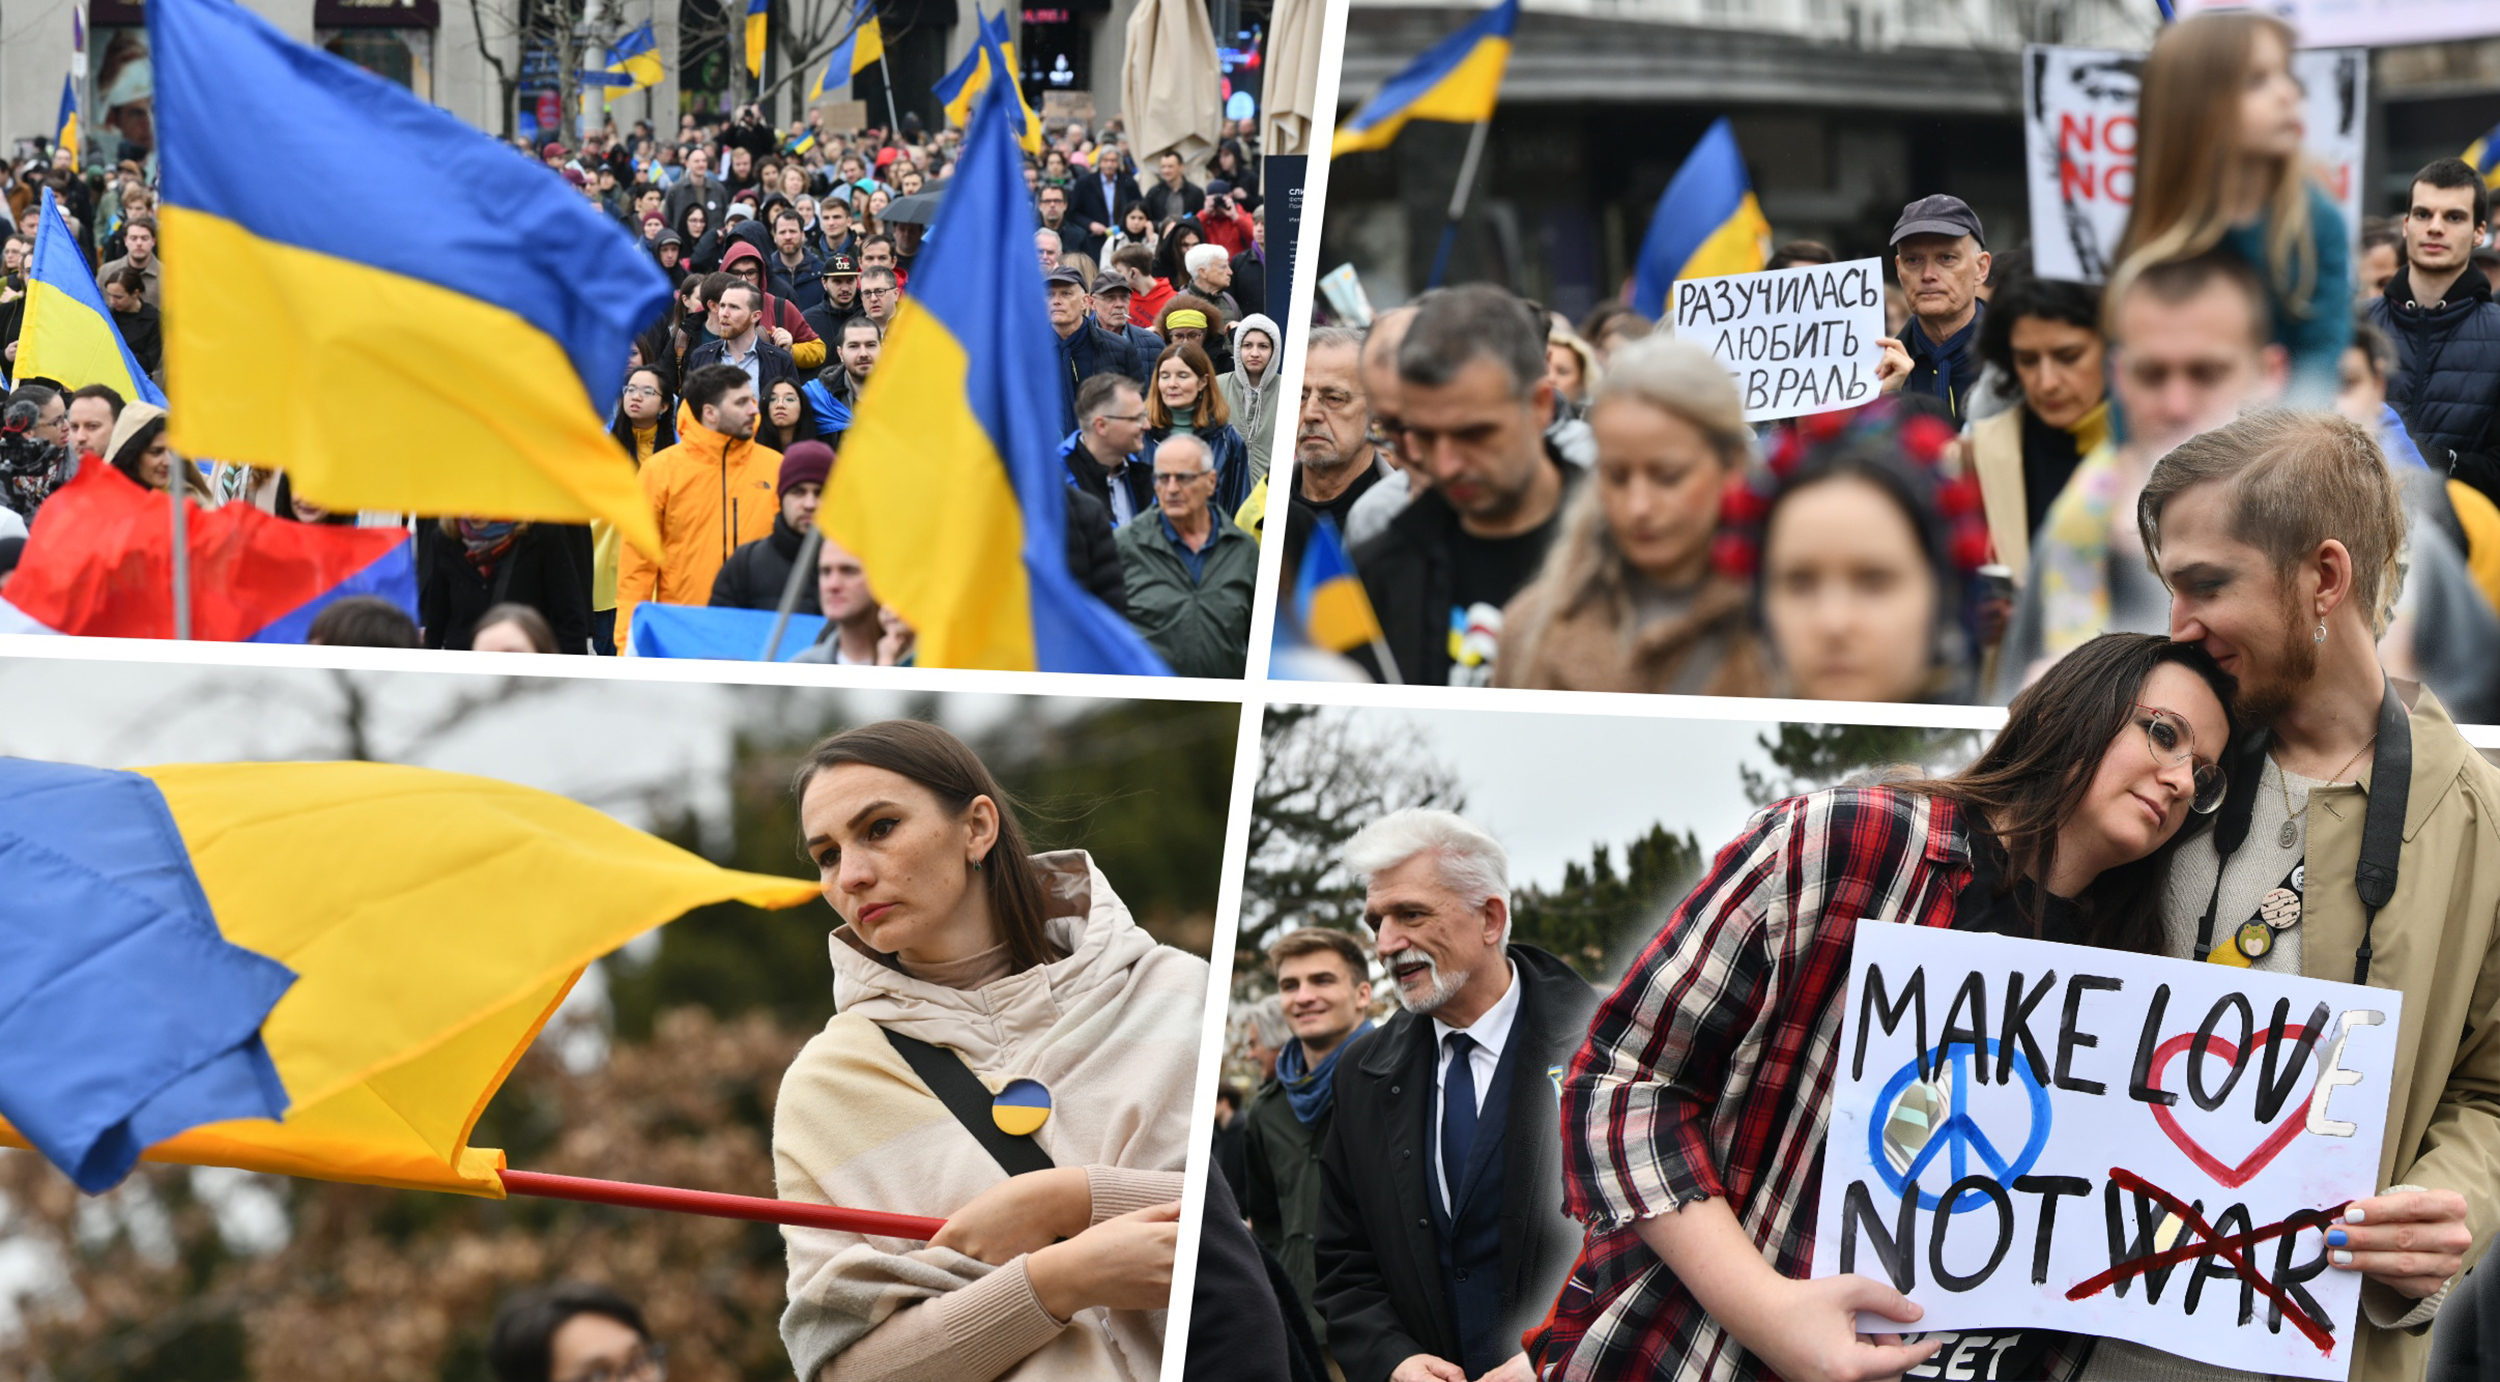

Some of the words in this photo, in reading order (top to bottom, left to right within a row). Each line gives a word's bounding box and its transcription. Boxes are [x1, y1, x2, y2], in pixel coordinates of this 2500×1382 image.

[1678, 267, 1878, 327] РАЗУЧИЛАСЬ
[1711, 320, 1859, 361] ЛЮБИТЬ
[1728, 361, 1868, 410] ВРАЛЬ
[1852, 962, 2124, 1096] MAKE
[1840, 1174, 2092, 1296] NOT
[2104, 1179, 2335, 1334] WAR
[1902, 1332, 2023, 1381] EET
